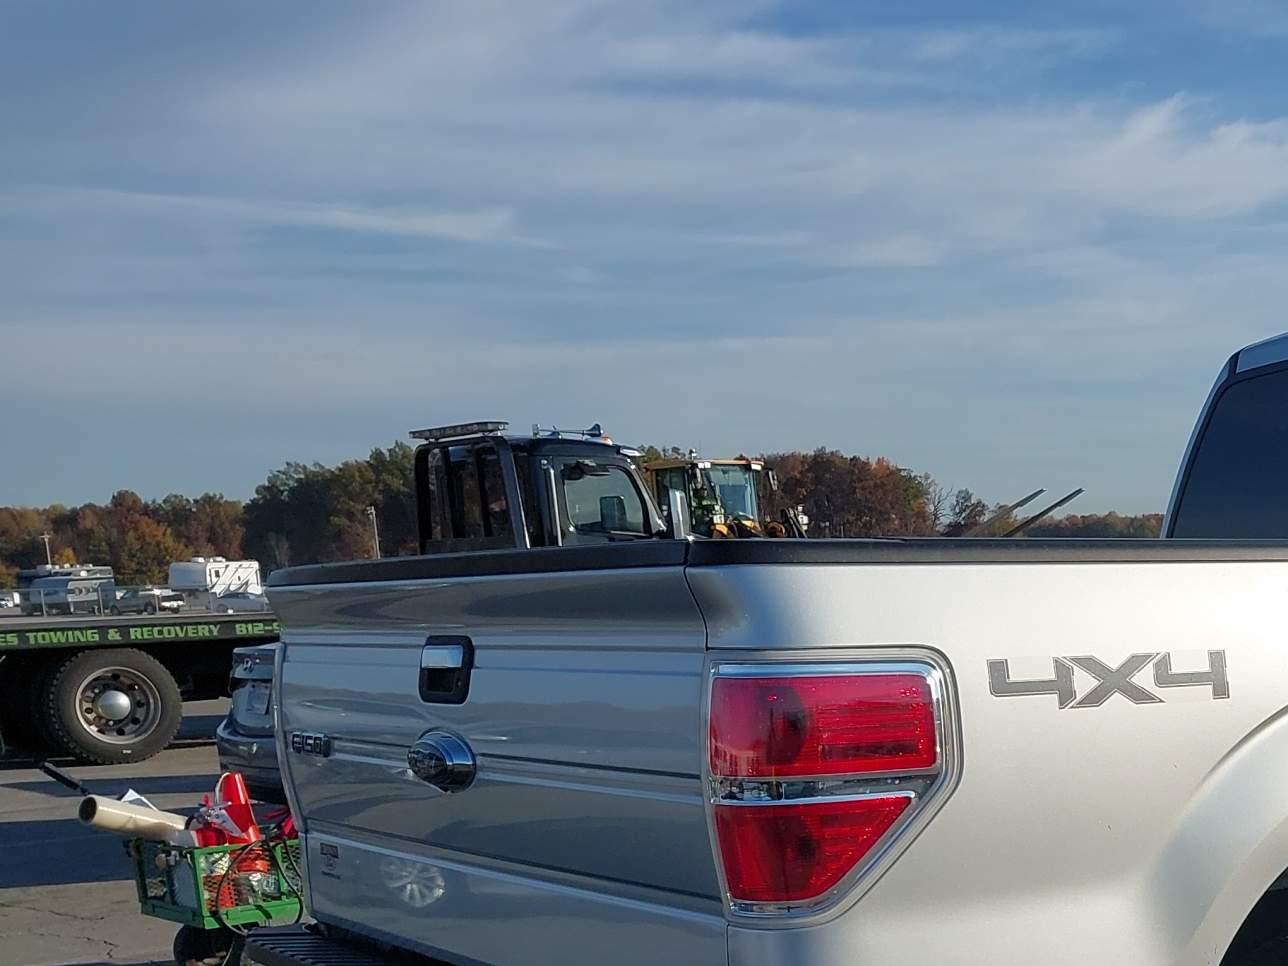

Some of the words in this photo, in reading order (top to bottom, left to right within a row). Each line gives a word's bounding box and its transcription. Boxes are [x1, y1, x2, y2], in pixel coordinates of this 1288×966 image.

[25, 629, 99, 645] TOWING
[107, 628, 122, 641] &
[129, 624, 220, 640] RECOVERY
